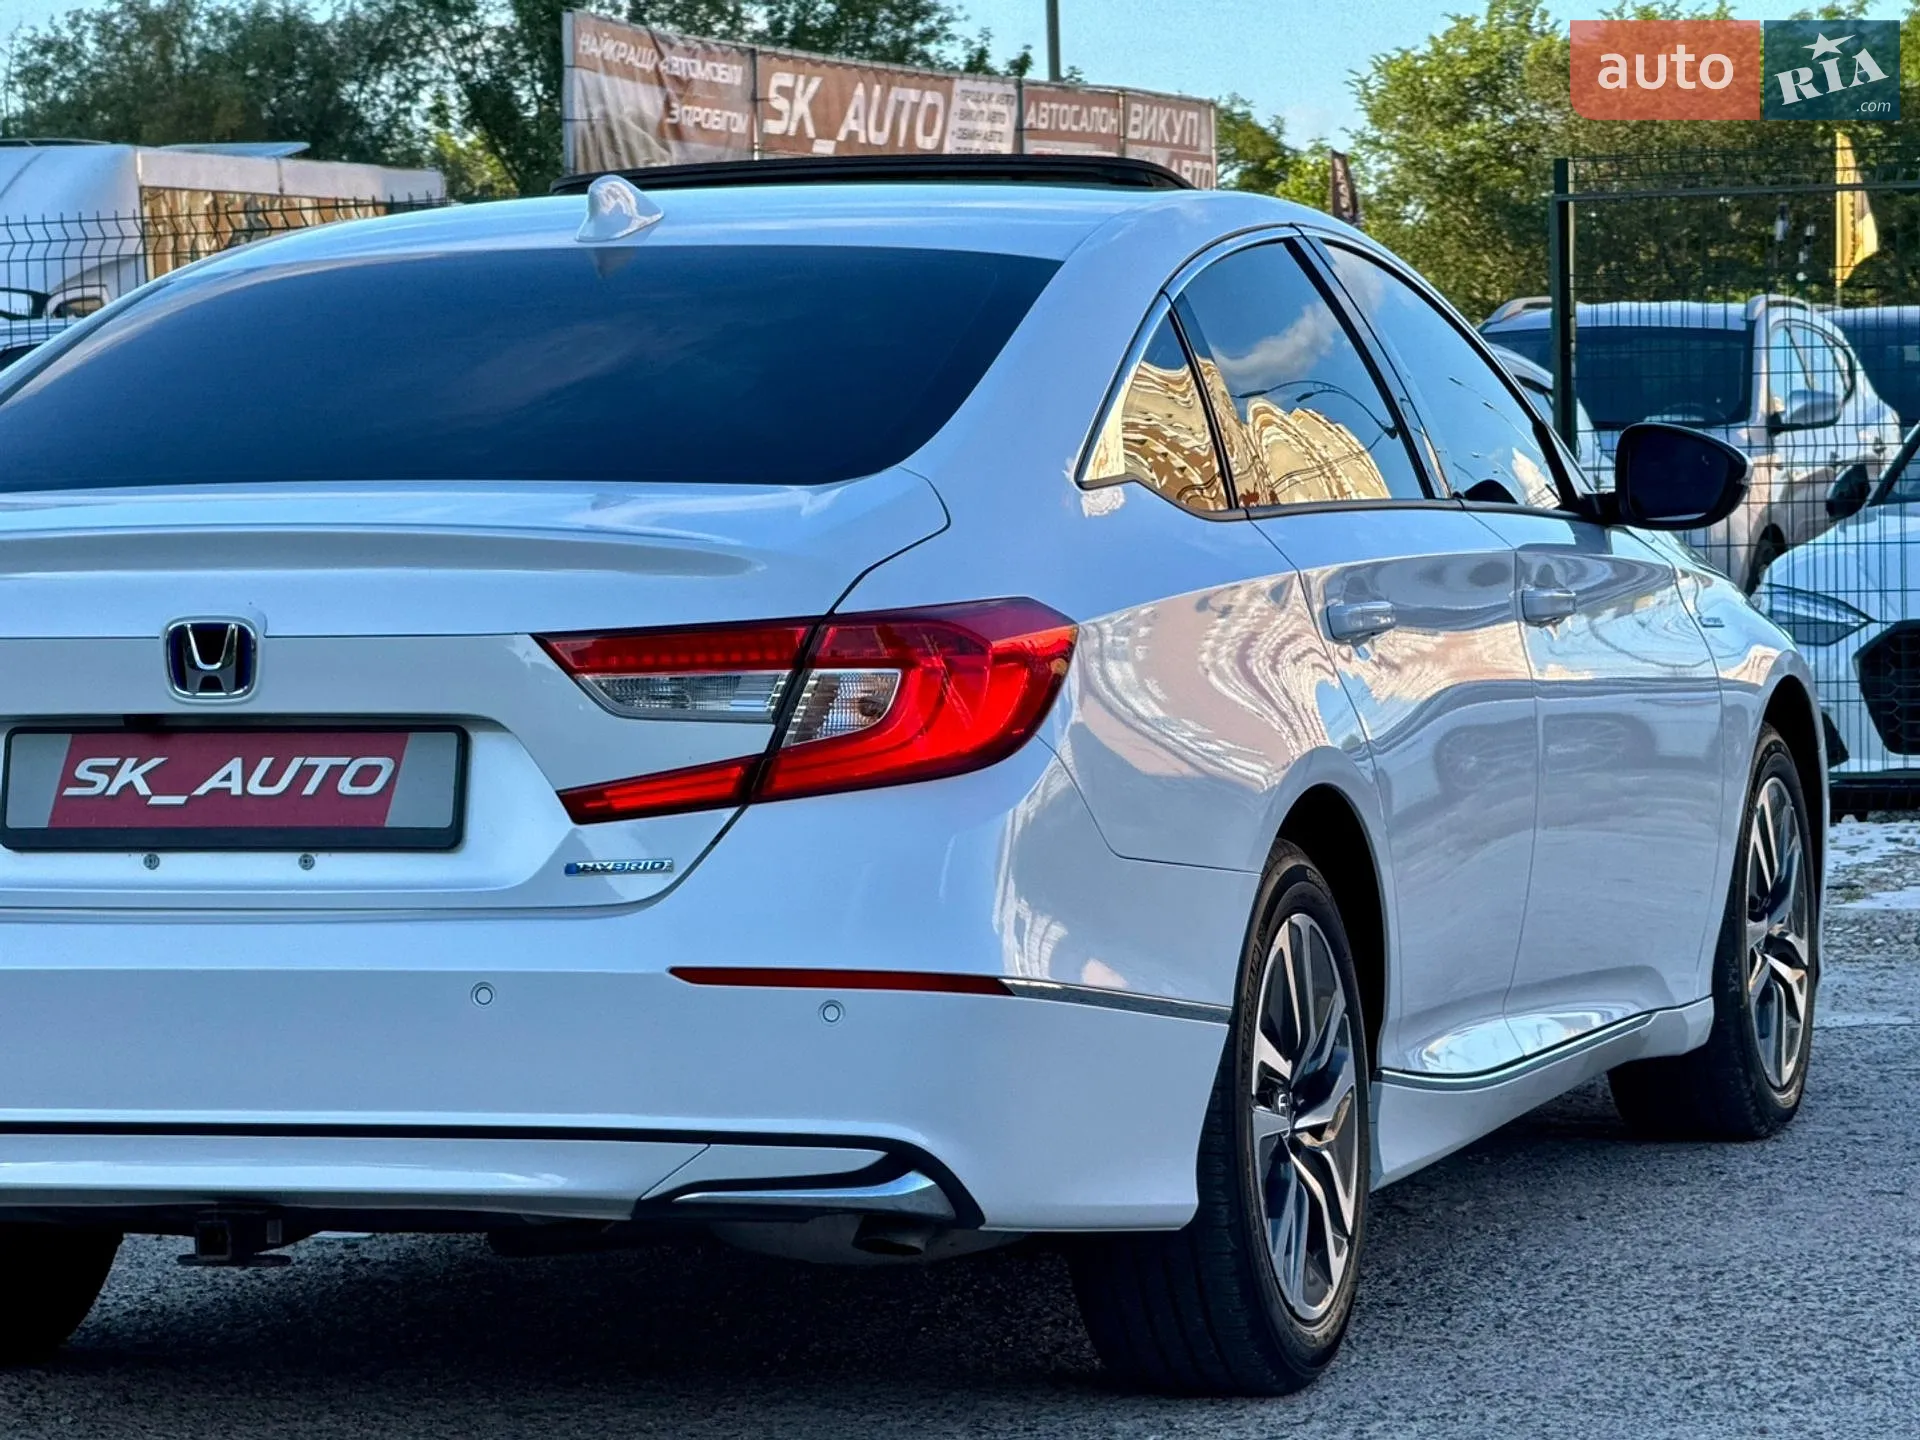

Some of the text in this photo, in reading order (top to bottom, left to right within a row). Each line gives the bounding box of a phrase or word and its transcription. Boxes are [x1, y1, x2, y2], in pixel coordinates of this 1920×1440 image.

[763, 72, 945, 155] SK_AUTO
[1024, 101, 1119, 134] АВТОСАЛОН
[1128, 103, 1199, 146] ВИКУП
[62, 756, 396, 805] SK_AUTO
[576, 860, 667, 874] HYBRID
